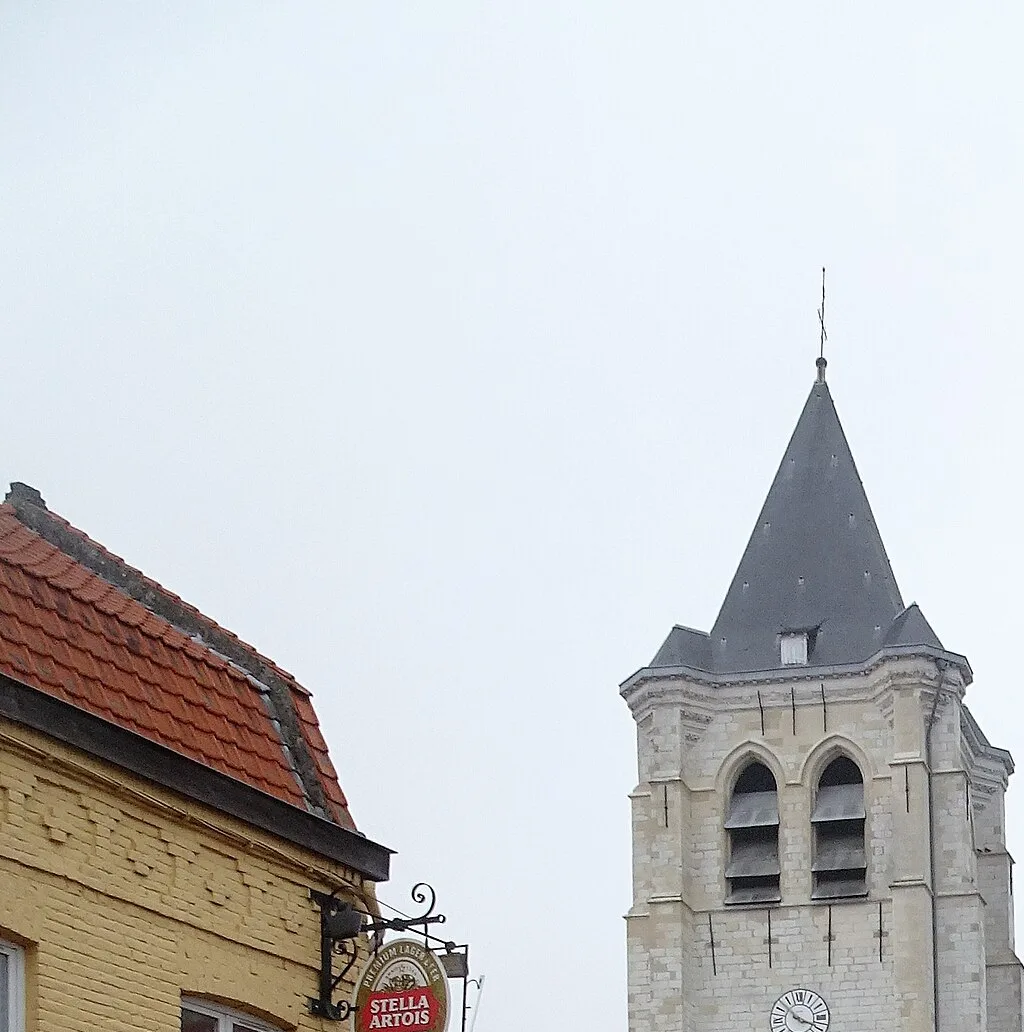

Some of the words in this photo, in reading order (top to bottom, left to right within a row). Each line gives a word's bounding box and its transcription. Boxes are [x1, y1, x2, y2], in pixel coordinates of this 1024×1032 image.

[363, 947, 397, 987] PREMIUM
[370, 995, 430, 1014] STELLA
[369, 1010, 430, 1029] ARTOIS
